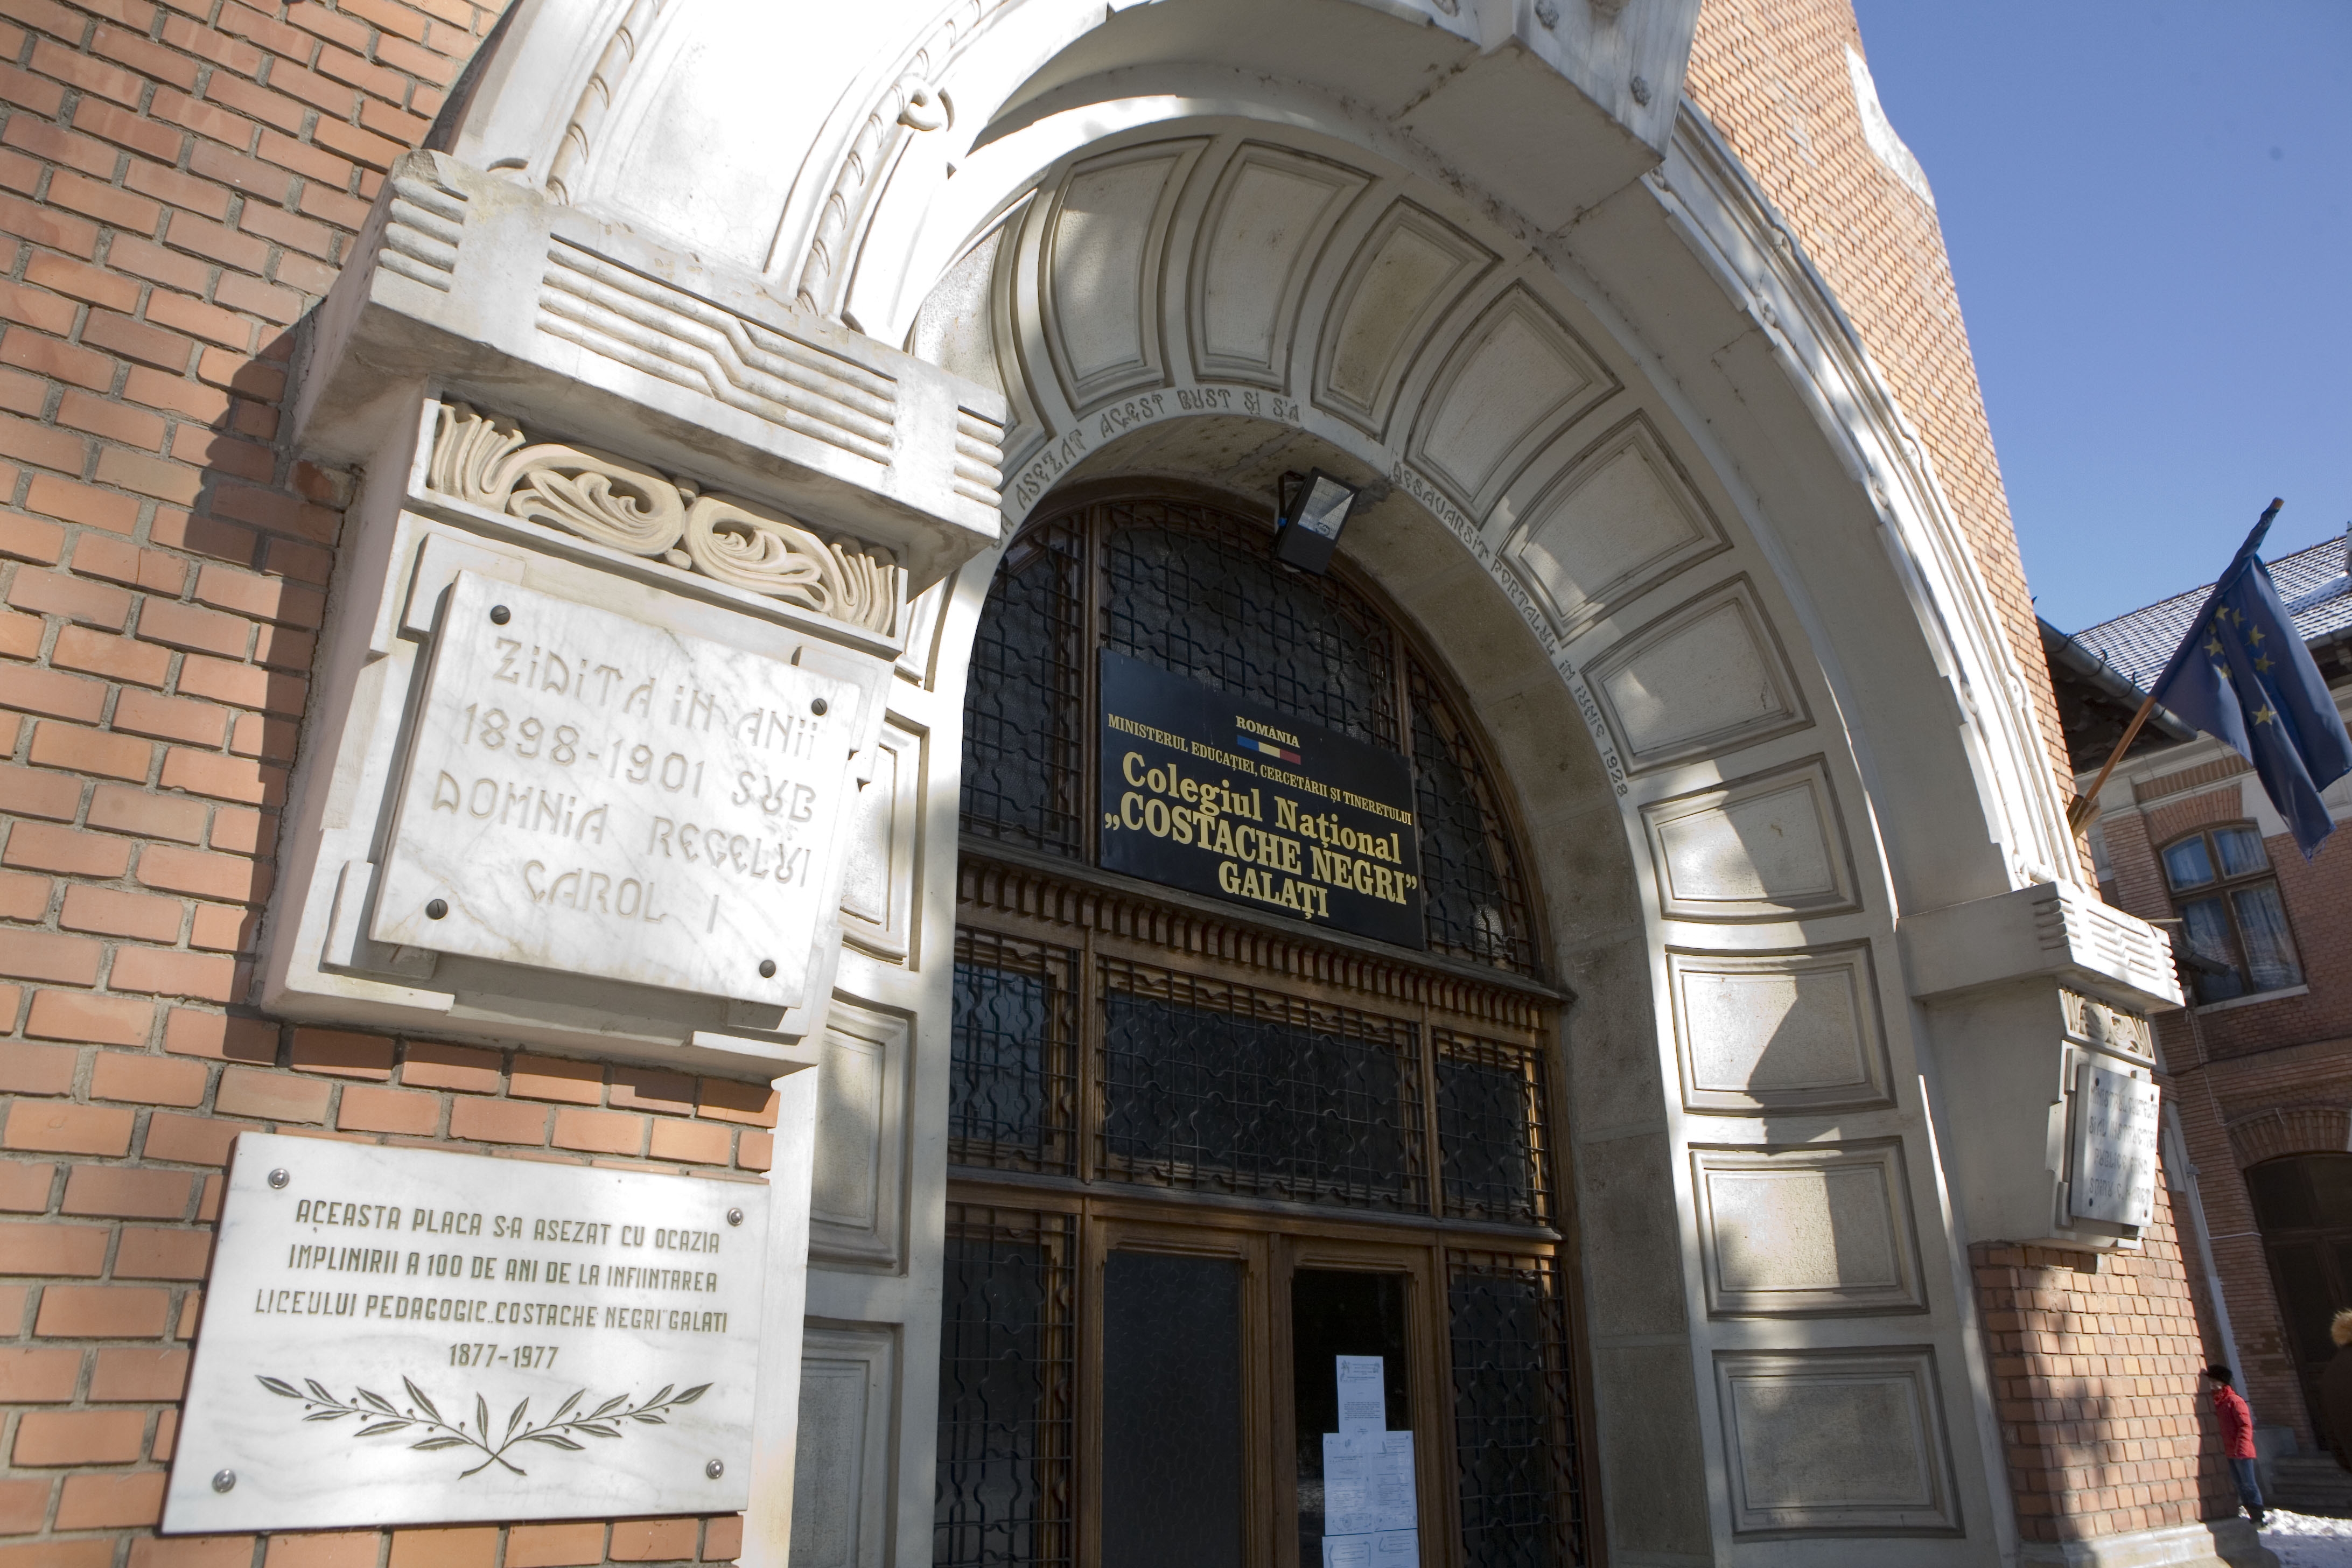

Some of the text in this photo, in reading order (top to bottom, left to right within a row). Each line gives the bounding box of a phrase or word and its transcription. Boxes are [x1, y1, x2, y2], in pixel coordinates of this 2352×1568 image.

[1100, 394, 1165, 438] ACEST
[1177, 388, 1231, 410] BUST
[1602, 747, 1628, 797] 1928
[463, 703, 816, 822] 1898-1901 SUB
[1236, 716, 1300, 748] ROMÂNIA
[1108, 713, 1188, 753] MINISTERUL
[1343, 791, 1412, 825] TINERETULUI
[1123, 752, 1263, 822] Colegiul
[647, 816, 811, 887] REGELUI
[523, 860, 719, 934] CAROL I
[296, 1199, 401, 1230] ACEASTA
[412, 1209, 482, 1236] PLACA
[534, 1219, 611, 1245] ASEZAT
[621, 1226, 645, 1247] CU
[655, 1228, 719, 1253] OCAZIA
[288, 1244, 717, 1292] IMPLINIRII A 100 DE ANI DE LA INFIINTAREA
[255, 1289, 356, 1316] LICEULUI
[366, 1295, 487, 1322] PEDAGOGIC
[669, 1311, 727, 1333] GALATI
[449, 1344, 559, 1369] 1877-1977
